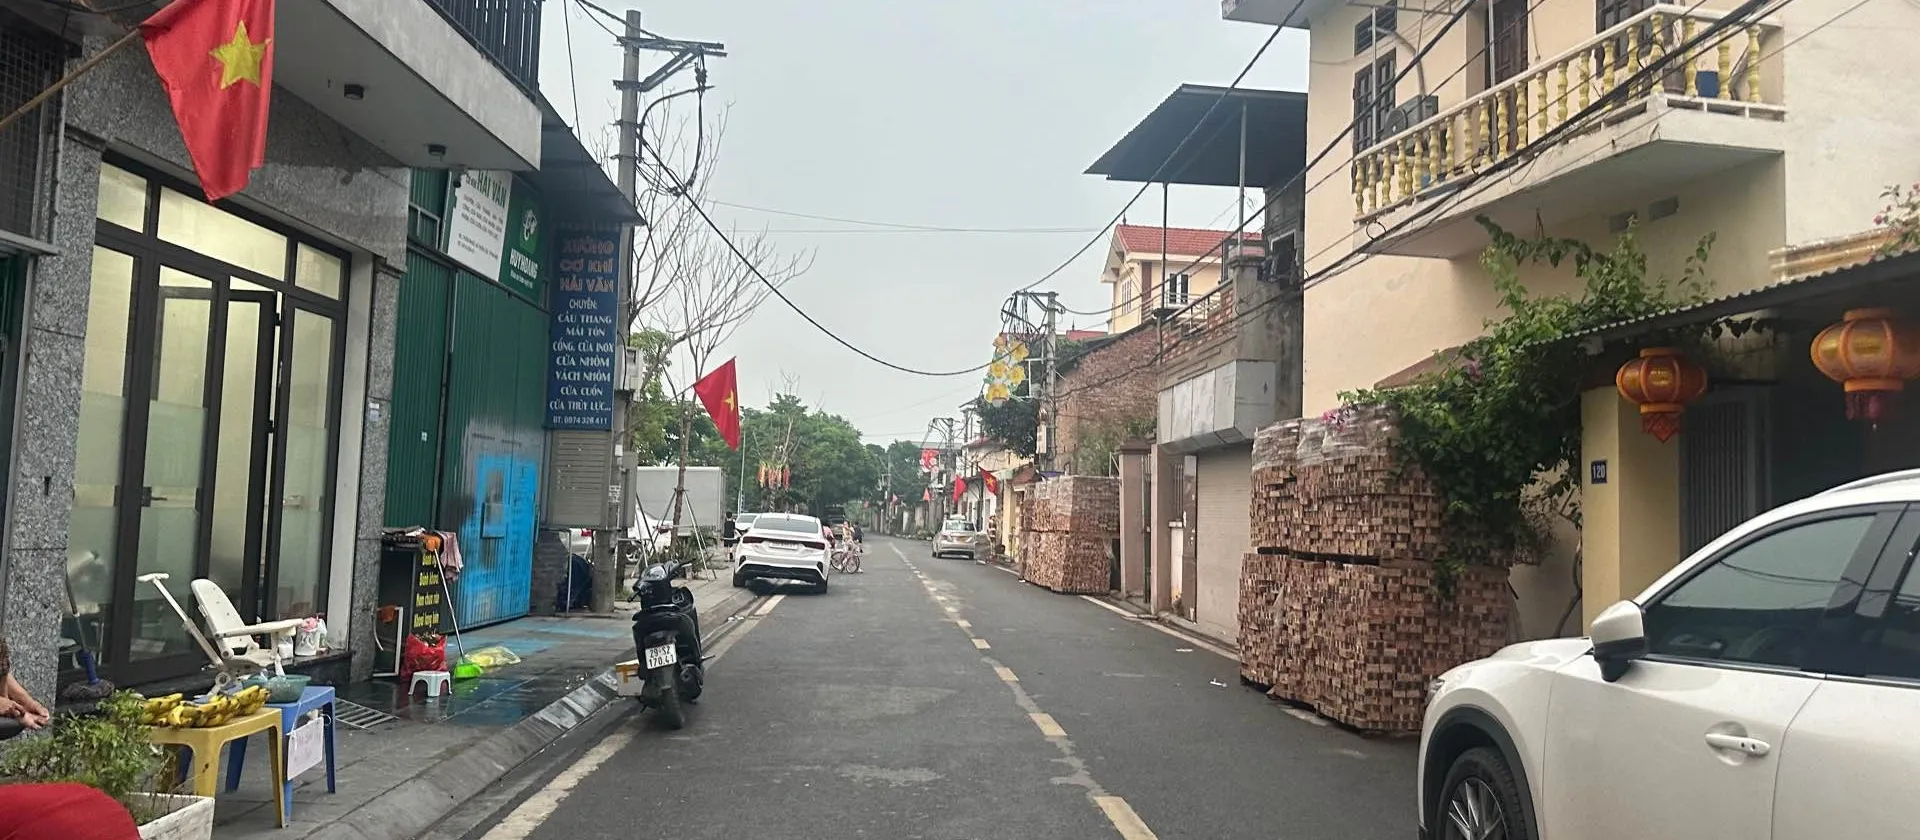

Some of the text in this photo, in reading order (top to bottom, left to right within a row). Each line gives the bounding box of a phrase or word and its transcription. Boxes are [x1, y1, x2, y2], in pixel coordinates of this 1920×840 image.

[509, 248, 538, 280] HUYHOANG
[560, 257, 614, 273] CƠ KHÍ
[560, 274, 583, 292] HẢI
[580, 314, 612, 324] THANG
[566, 324, 606, 337] MÁI TÔN
[578, 340, 594, 352] CỬA
[596, 342, 614, 353] INOX
[556, 354, 610, 367] CỬA NHÔM
[555, 368, 611, 381] VÁCH NHÔM
[560, 384, 603, 396] CỬA CUỐN
[549, 398, 565, 410] CỬA
[1592, 464, 1606, 479] 120
